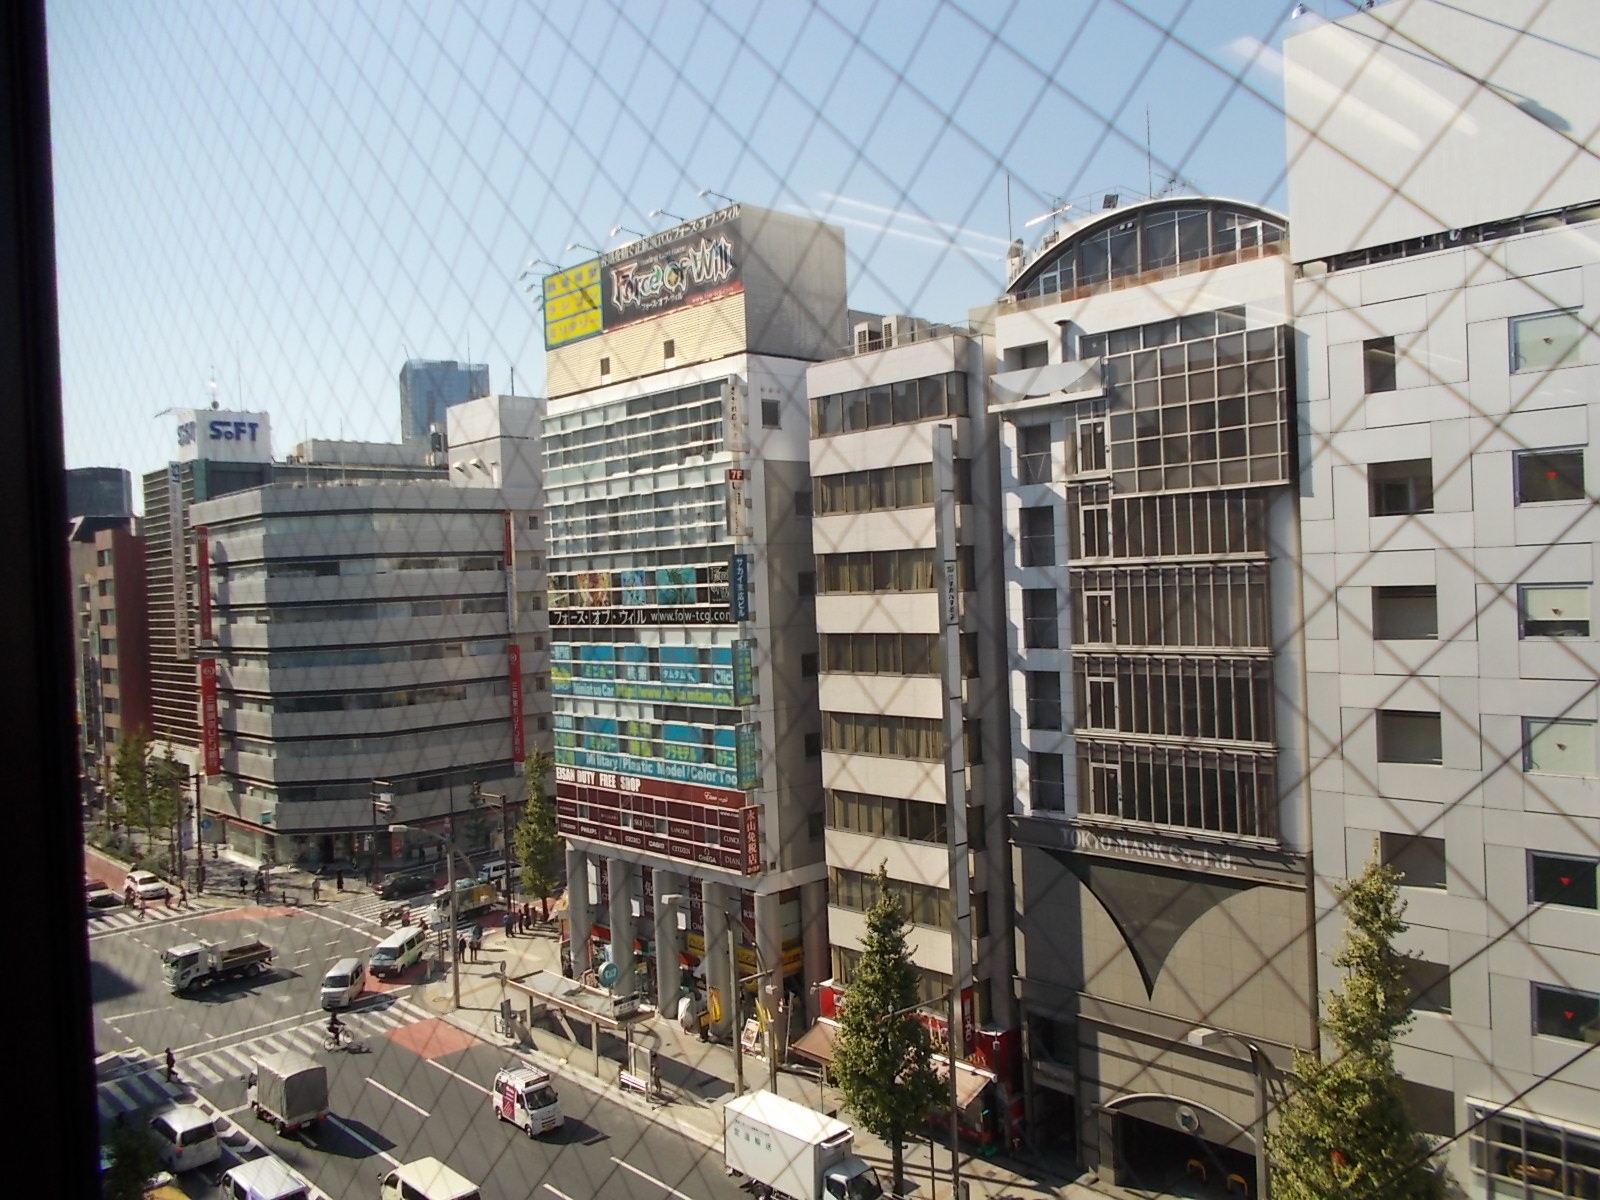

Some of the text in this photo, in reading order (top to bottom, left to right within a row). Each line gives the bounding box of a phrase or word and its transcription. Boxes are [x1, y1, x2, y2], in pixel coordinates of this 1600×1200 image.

[731, 470, 742, 480] 7F
[556, 766, 641, 792] EISAN DUTY FREE SHOP
[691, 766, 717, 781] Color
[1062, 828, 1111, 850] TOKYO
[1117, 837, 1167, 860] MARK
